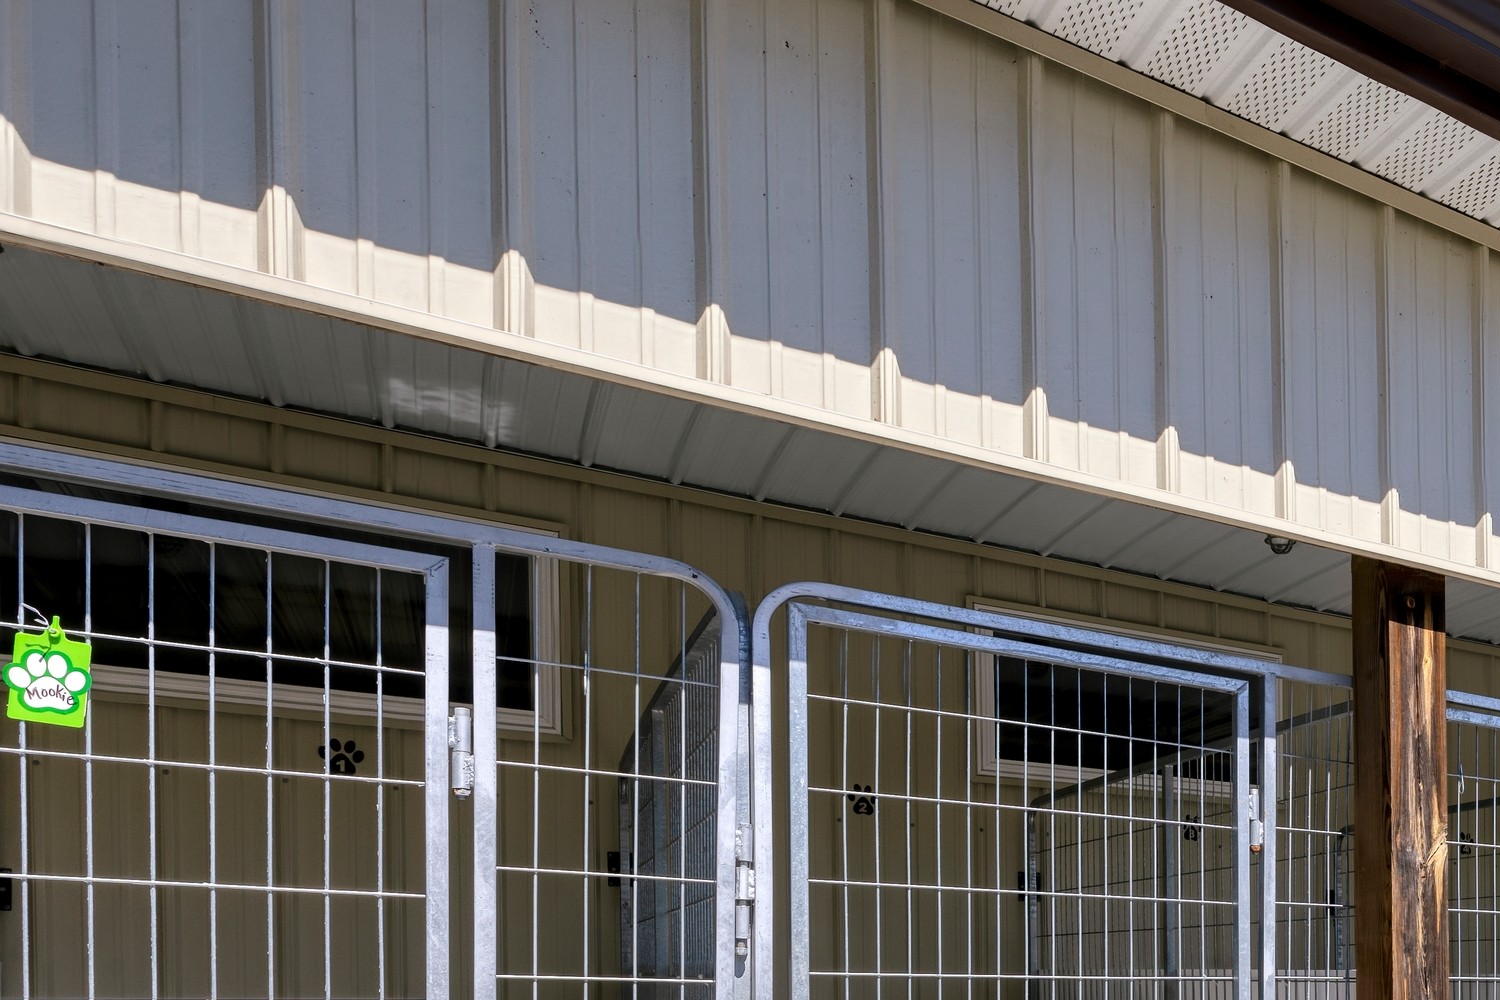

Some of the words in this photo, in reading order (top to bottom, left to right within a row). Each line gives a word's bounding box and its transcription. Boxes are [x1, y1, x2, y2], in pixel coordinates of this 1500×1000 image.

[26, 684, 78, 706] Mookie
[336, 759, 345, 772] 1
[858, 802, 867, 813] 2
